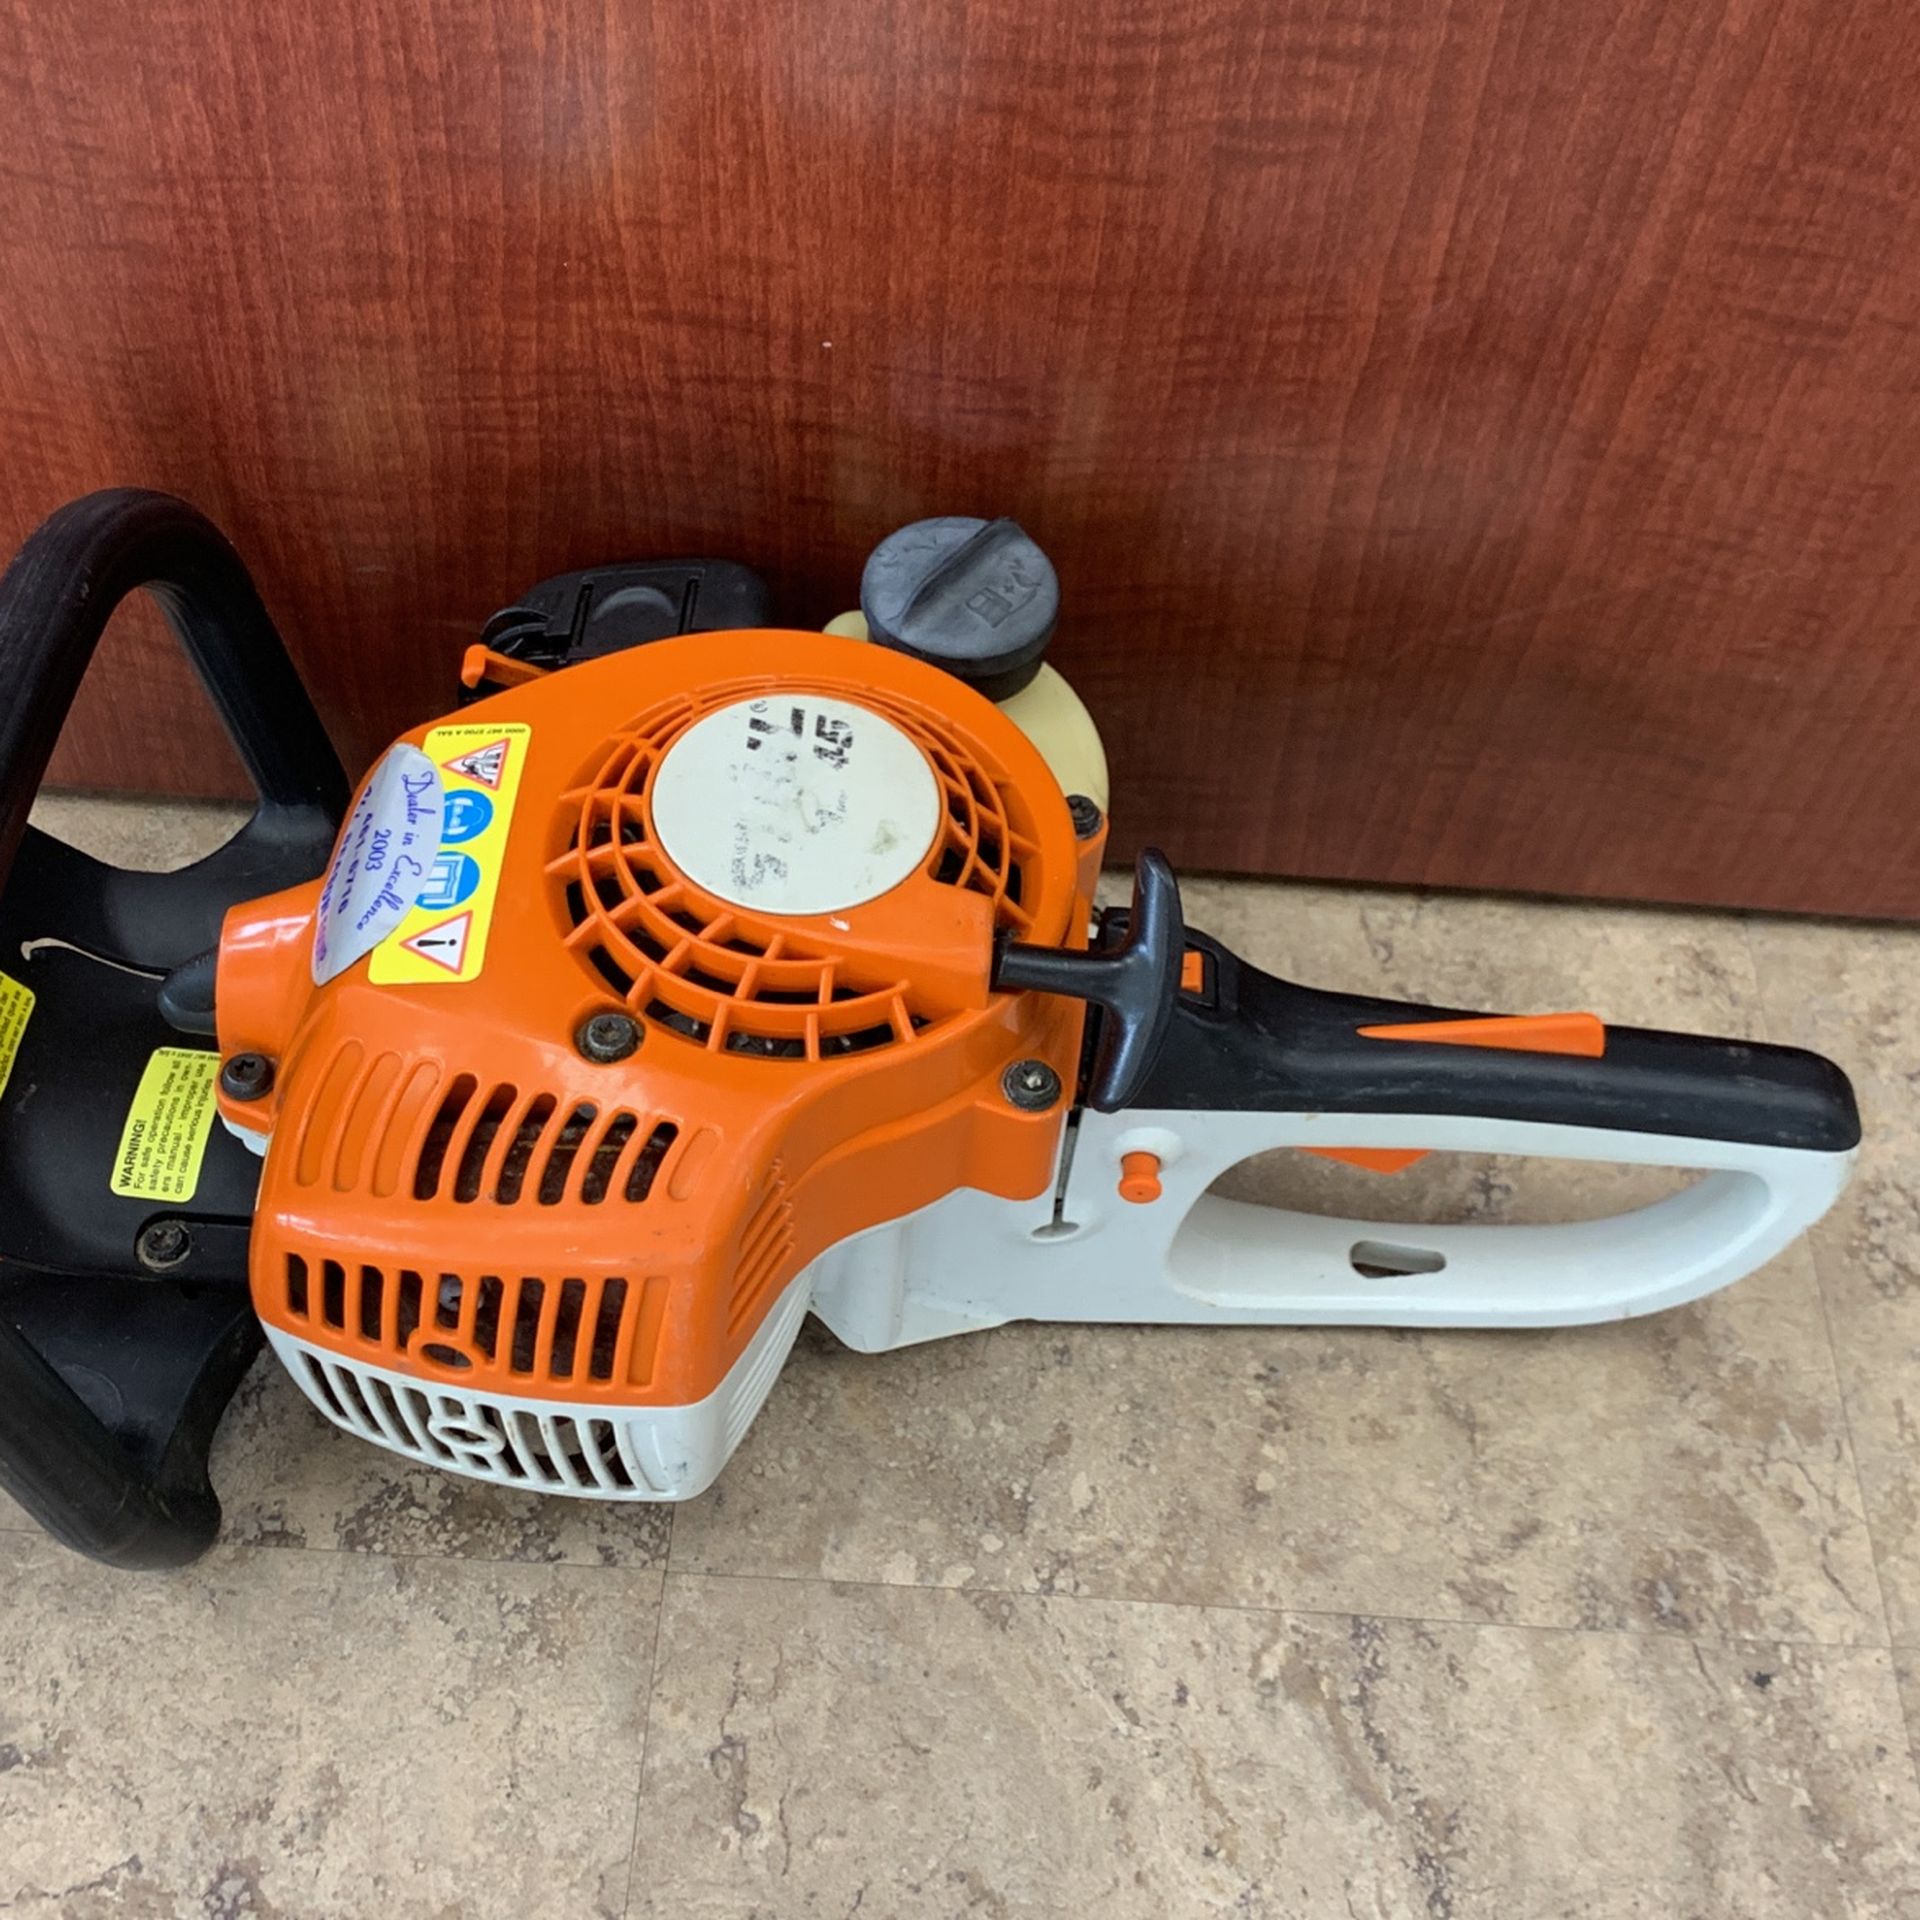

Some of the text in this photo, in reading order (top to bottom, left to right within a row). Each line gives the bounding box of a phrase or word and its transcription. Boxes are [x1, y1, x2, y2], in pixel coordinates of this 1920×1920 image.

[356, 770, 436, 931] Dealer in Excellence
[364, 829, 392, 872] 2003
[194, 1062, 208, 1079] use
[133, 1060, 182, 1190] For safe operation follow all
[148, 1158, 164, 1192] safety
[156, 1096, 181, 1155] precautions
[174, 1084, 186, 1094] in
[186, 1108, 204, 1143] serious
[118, 1118, 147, 1189] WARNING!
[166, 1131, 183, 1172] manual
[178, 1143, 194, 1174] cause
[161, 1175, 173, 1193] ers
[174, 1174, 186, 1196] can
